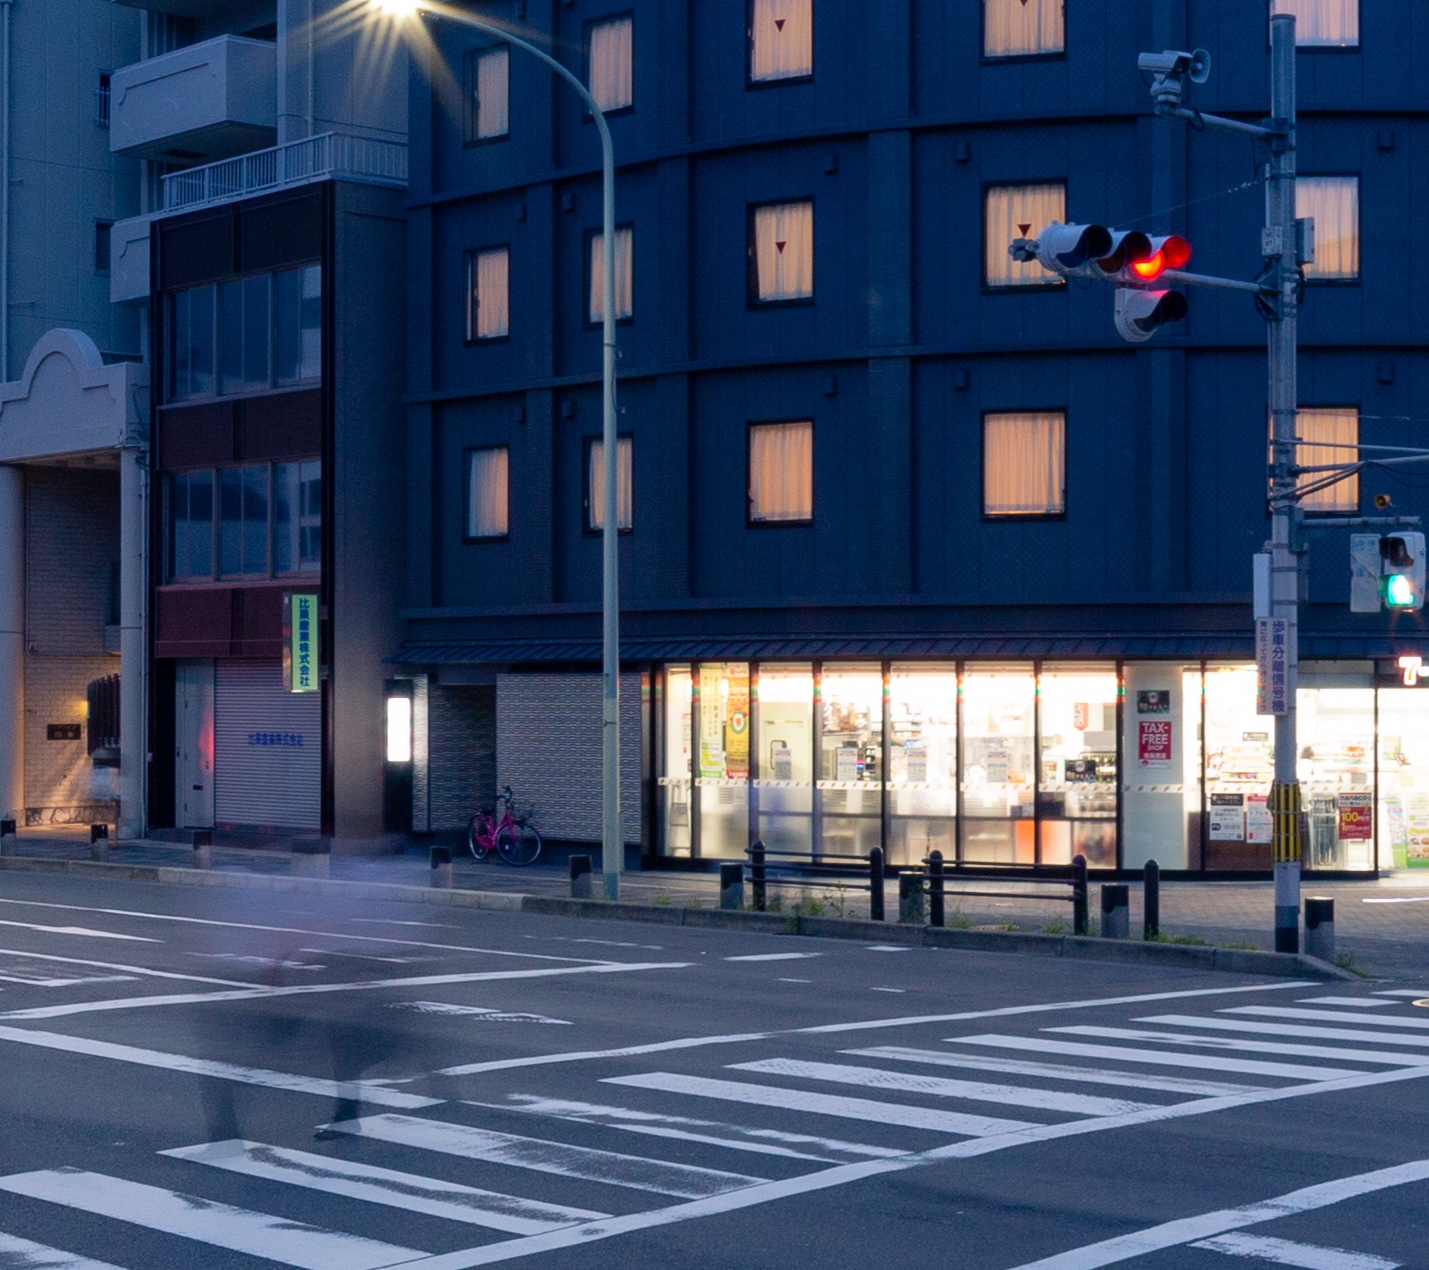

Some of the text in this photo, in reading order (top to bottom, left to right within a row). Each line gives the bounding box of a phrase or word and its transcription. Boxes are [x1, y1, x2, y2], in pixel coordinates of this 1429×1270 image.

[1272, 620, 1285, 713] 歩車分離信号機
[1142, 722, 1168, 733] TAX-
[1142, 734, 1168, 745] FREE
